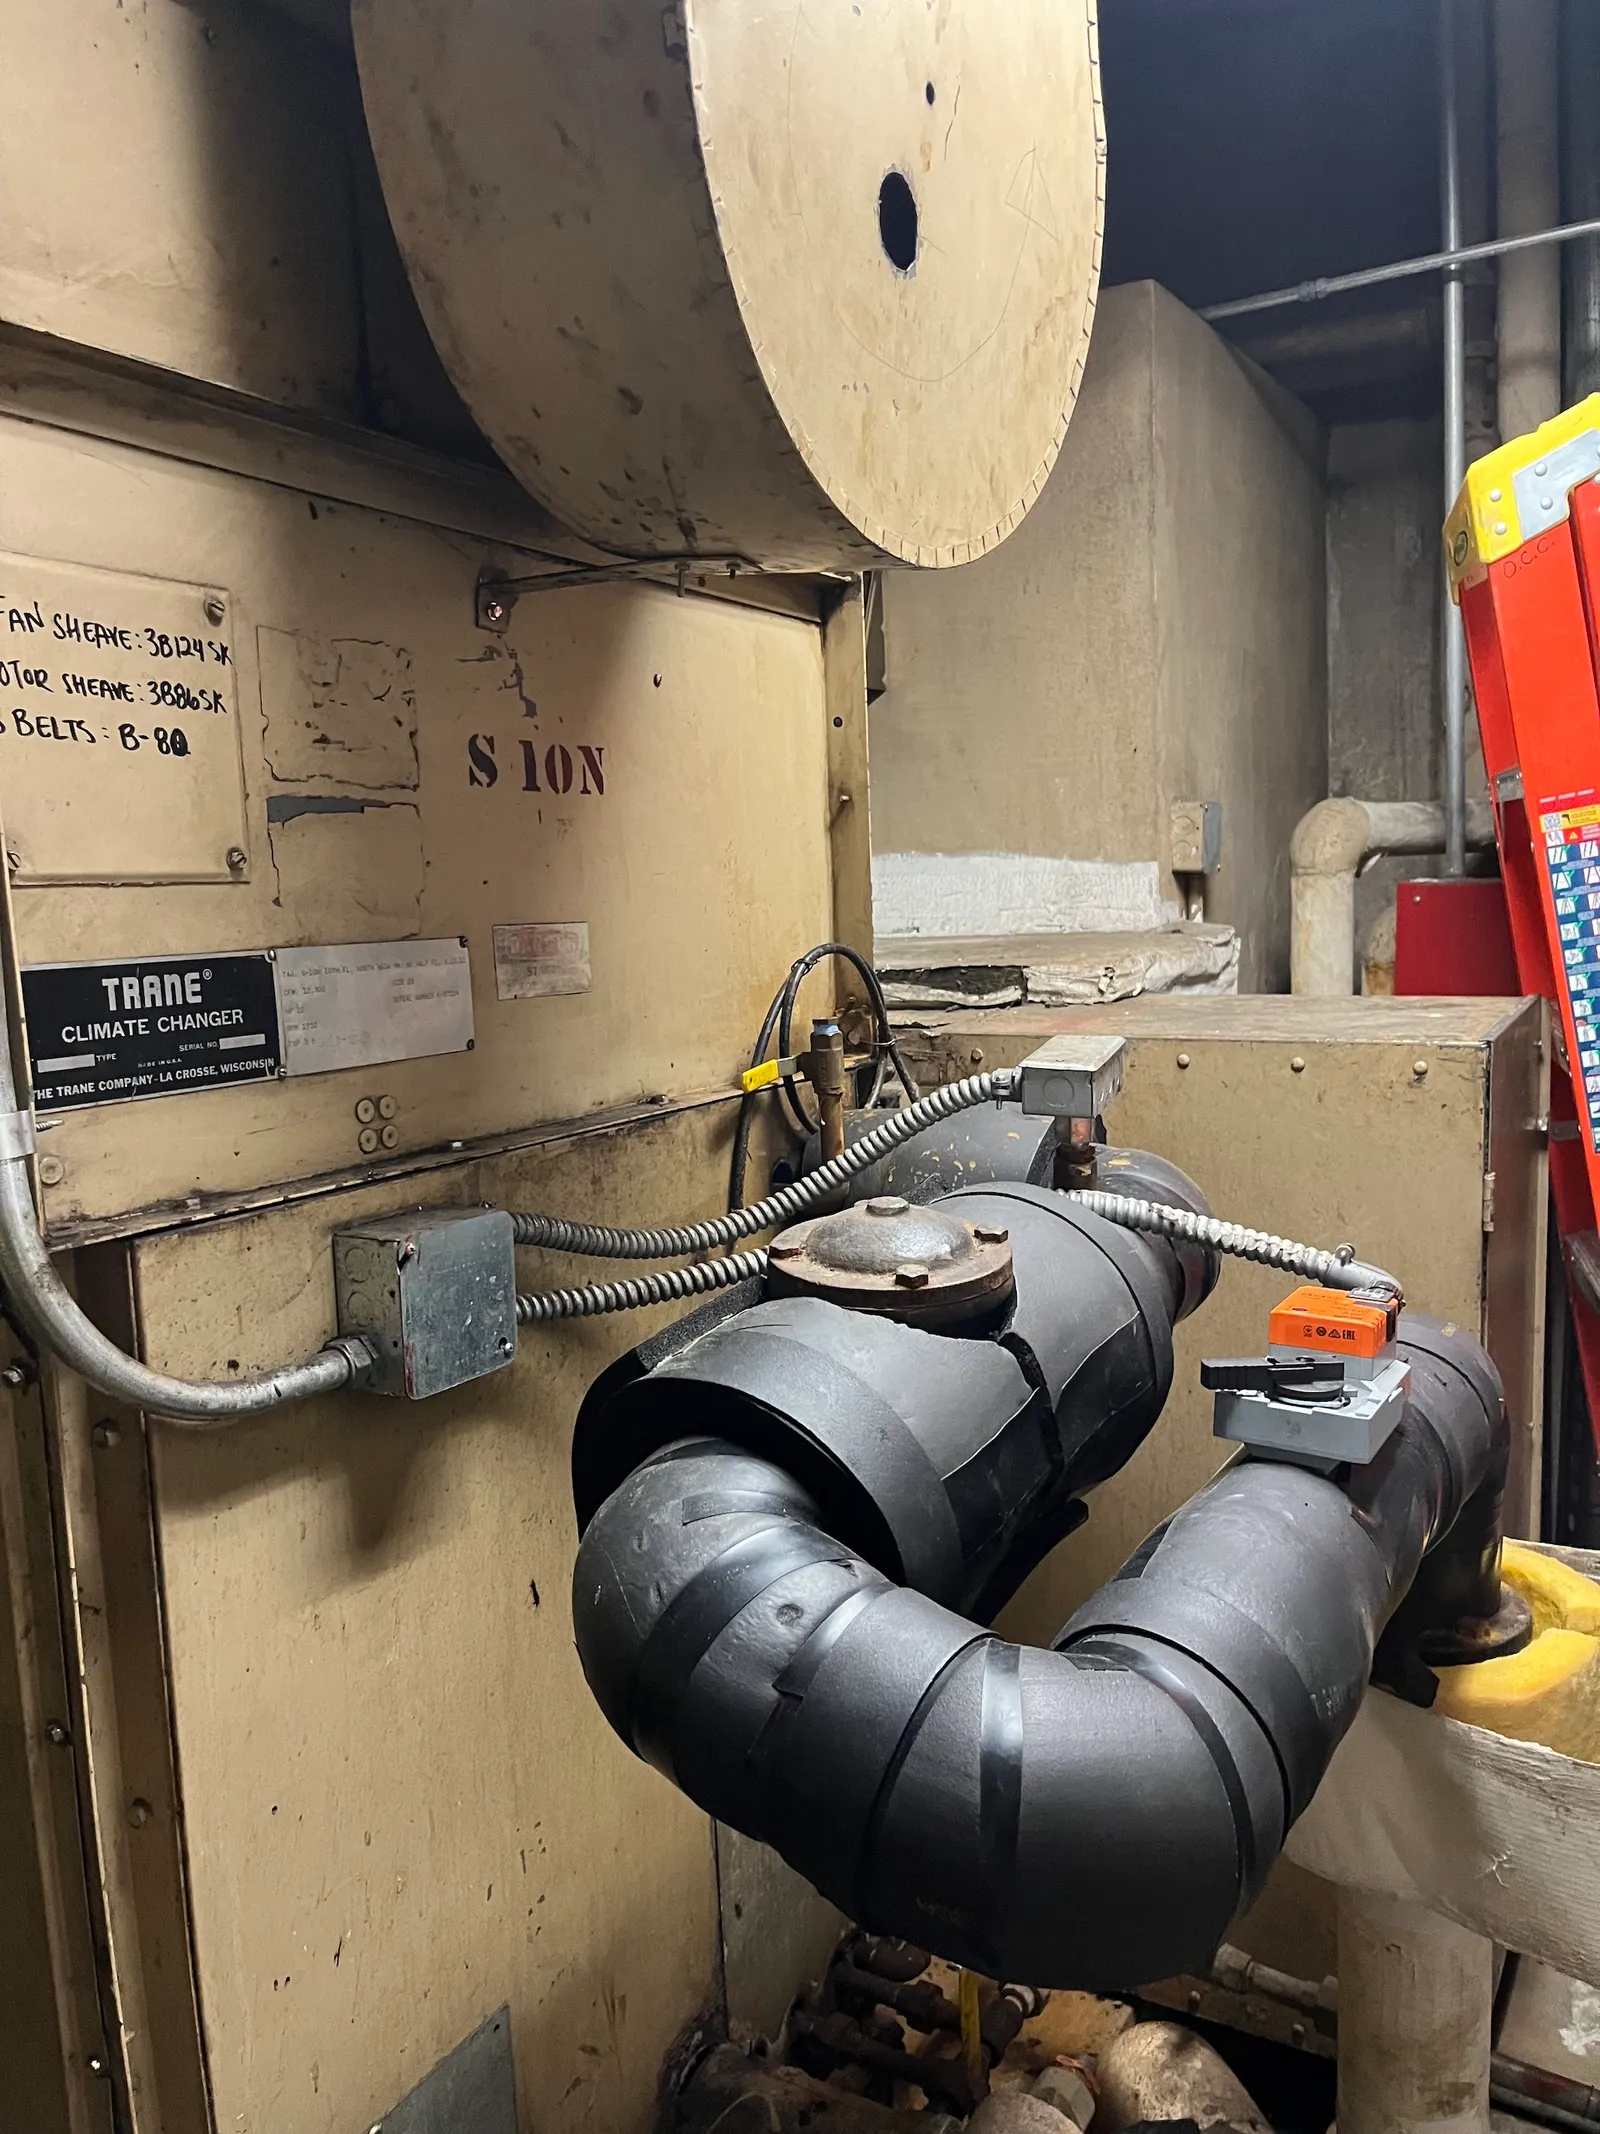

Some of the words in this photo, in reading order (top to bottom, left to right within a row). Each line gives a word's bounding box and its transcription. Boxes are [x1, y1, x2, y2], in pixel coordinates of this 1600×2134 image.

[468, 733, 498, 788] S
[61, 1018, 150, 1043] CLIMATE
[157, 1008, 244, 1033] CHANGER
[96, 1052, 118, 1063] TYPE
[178, 1042, 205, 1053] SERIAL
[56, 1082, 96, 1098] TRANE
[175, 1066, 219, 1081] CROSSE,
[221, 1057, 275, 1076] WISCONSIN
